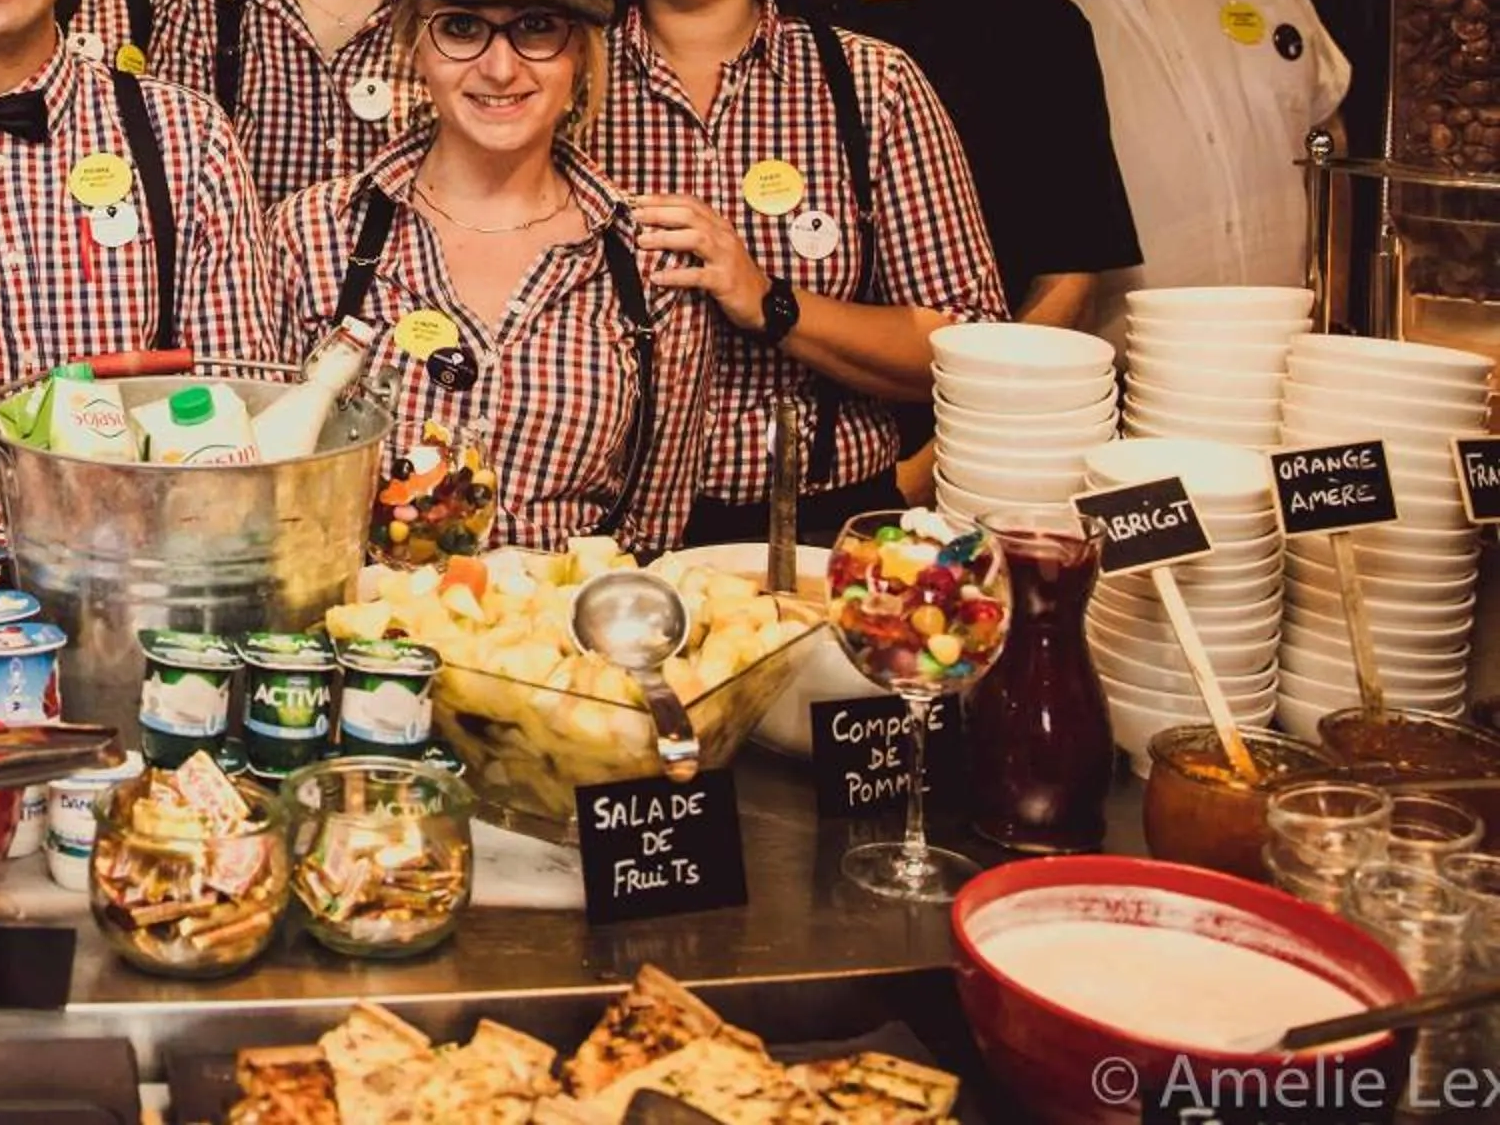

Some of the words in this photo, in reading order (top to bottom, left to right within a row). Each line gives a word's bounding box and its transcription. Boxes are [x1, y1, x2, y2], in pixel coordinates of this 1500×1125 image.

[1279, 449, 1378, 480] ORANGE
[1291, 477, 1377, 514] AMÈRE
[253, 682, 332, 710] ACTIVIA
[832, 704, 944, 746] COMPOE
[868, 747, 901, 770] DE
[593, 791, 706, 829] SALADE
[642, 827, 674, 856] DE
